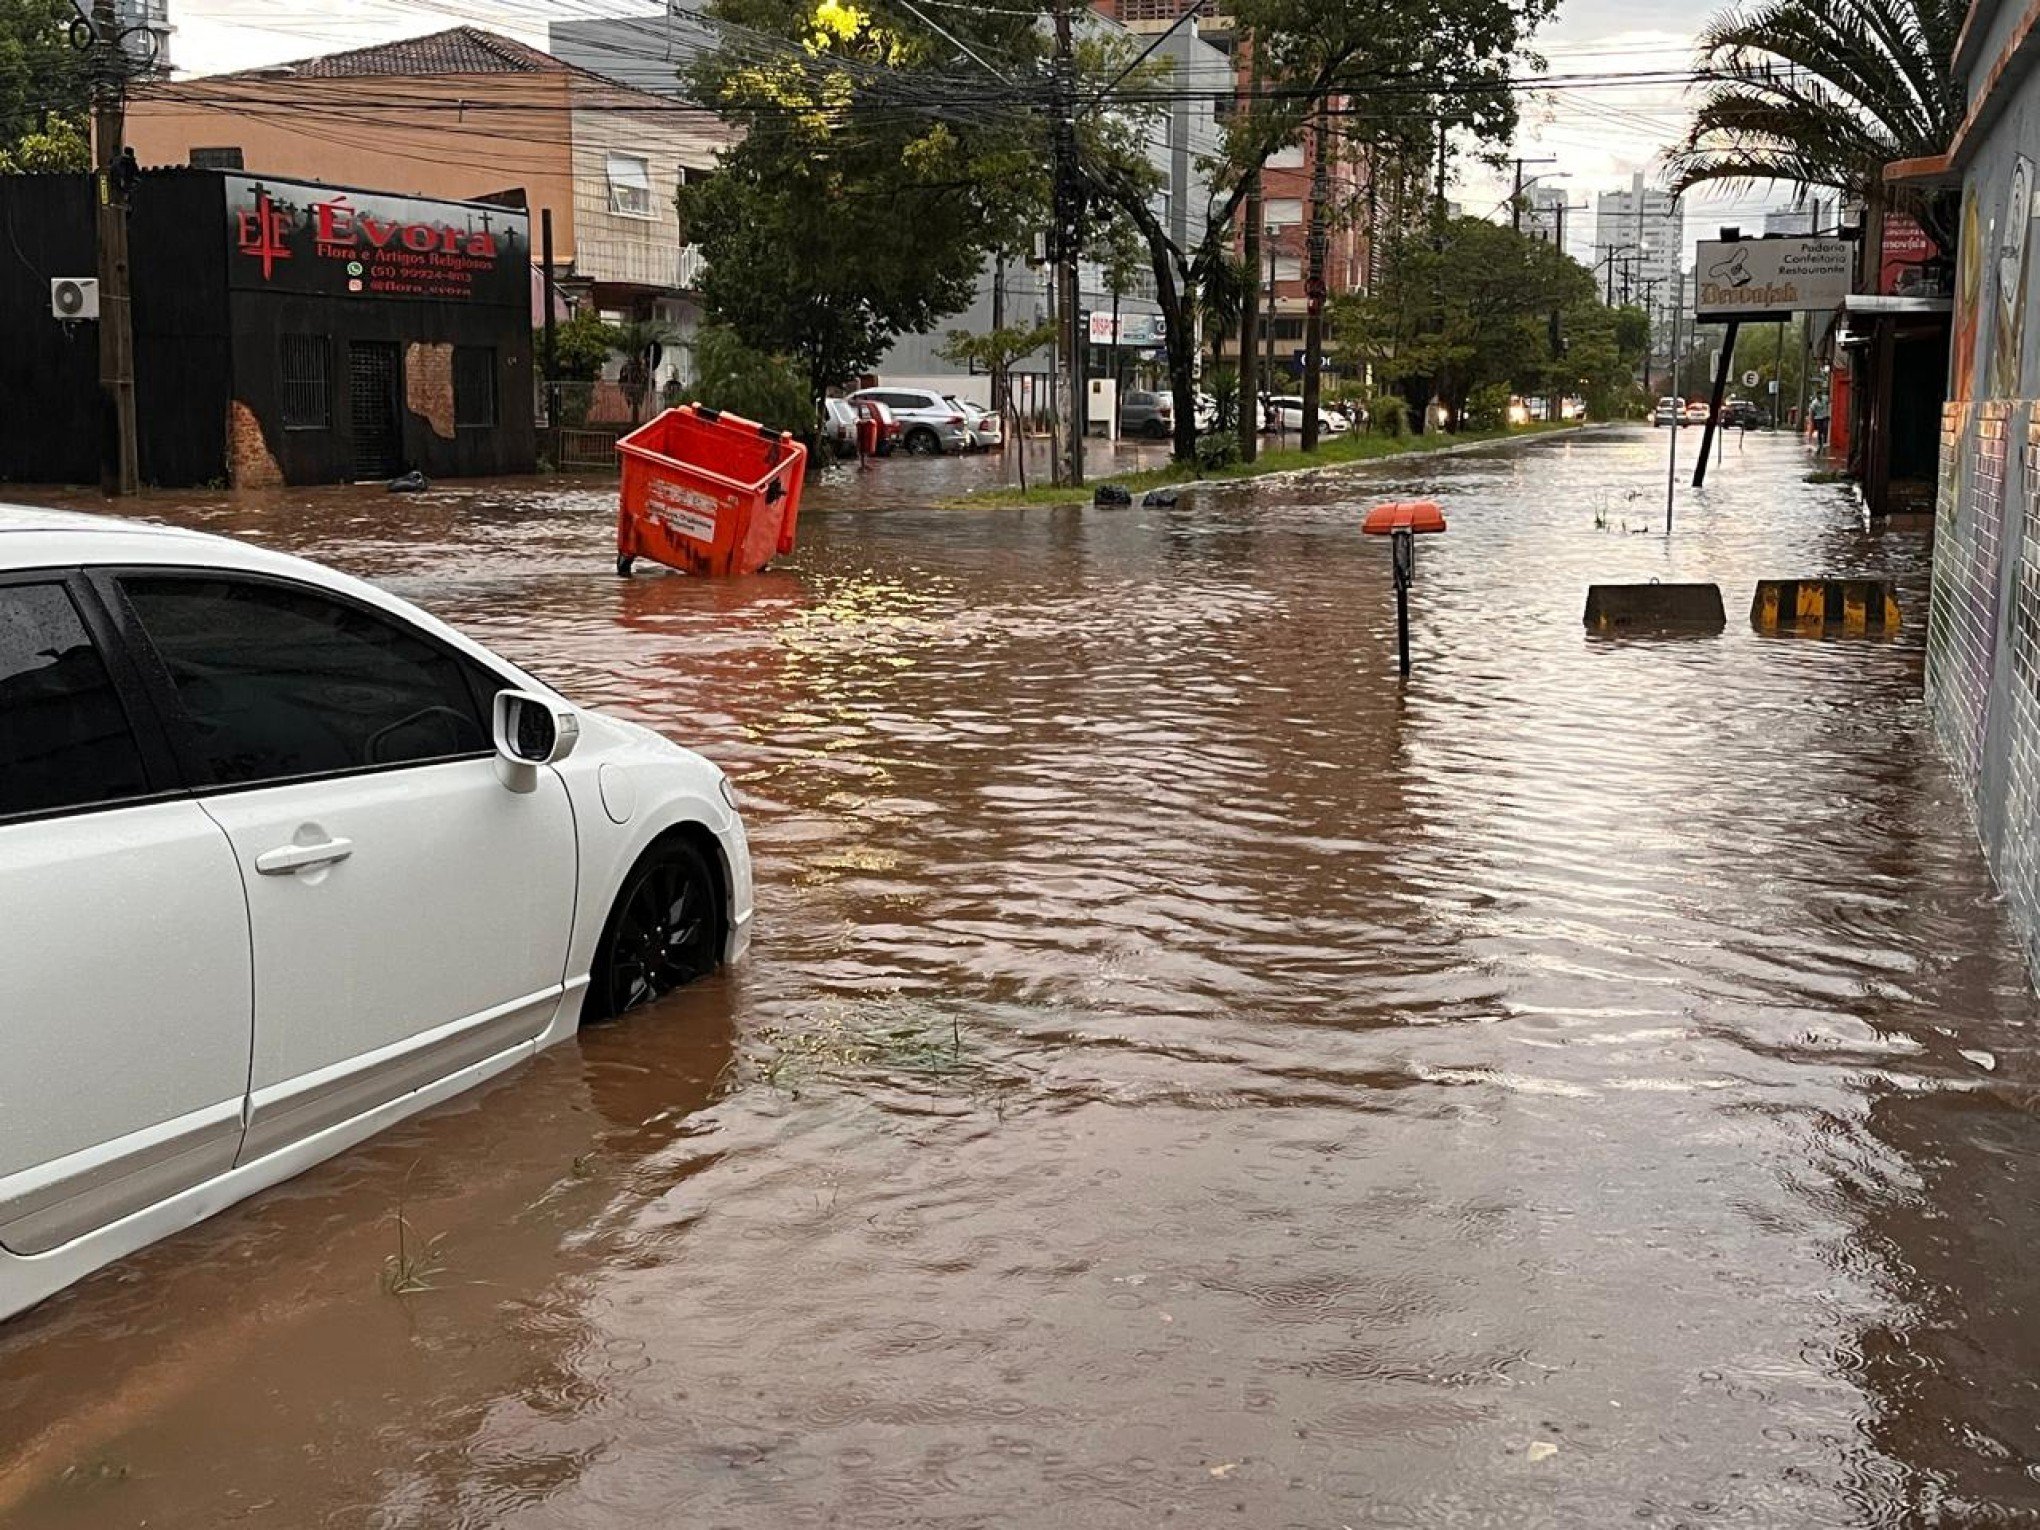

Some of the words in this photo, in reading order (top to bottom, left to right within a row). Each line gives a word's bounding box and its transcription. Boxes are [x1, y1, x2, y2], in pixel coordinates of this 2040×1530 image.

[316, 195, 497, 257] Évora
[1801, 243, 1846, 253] Padaria
[316, 243, 356, 260] Flora
[361, 248, 371, 261] e
[375, 248, 426, 264] Artigos
[428, 253, 493, 270] Religiosos
[1784, 253, 1846, 264] Confeitaria
[1778, 265, 1845, 275] Restaurante
[1746, 373, 1755, 384] E
